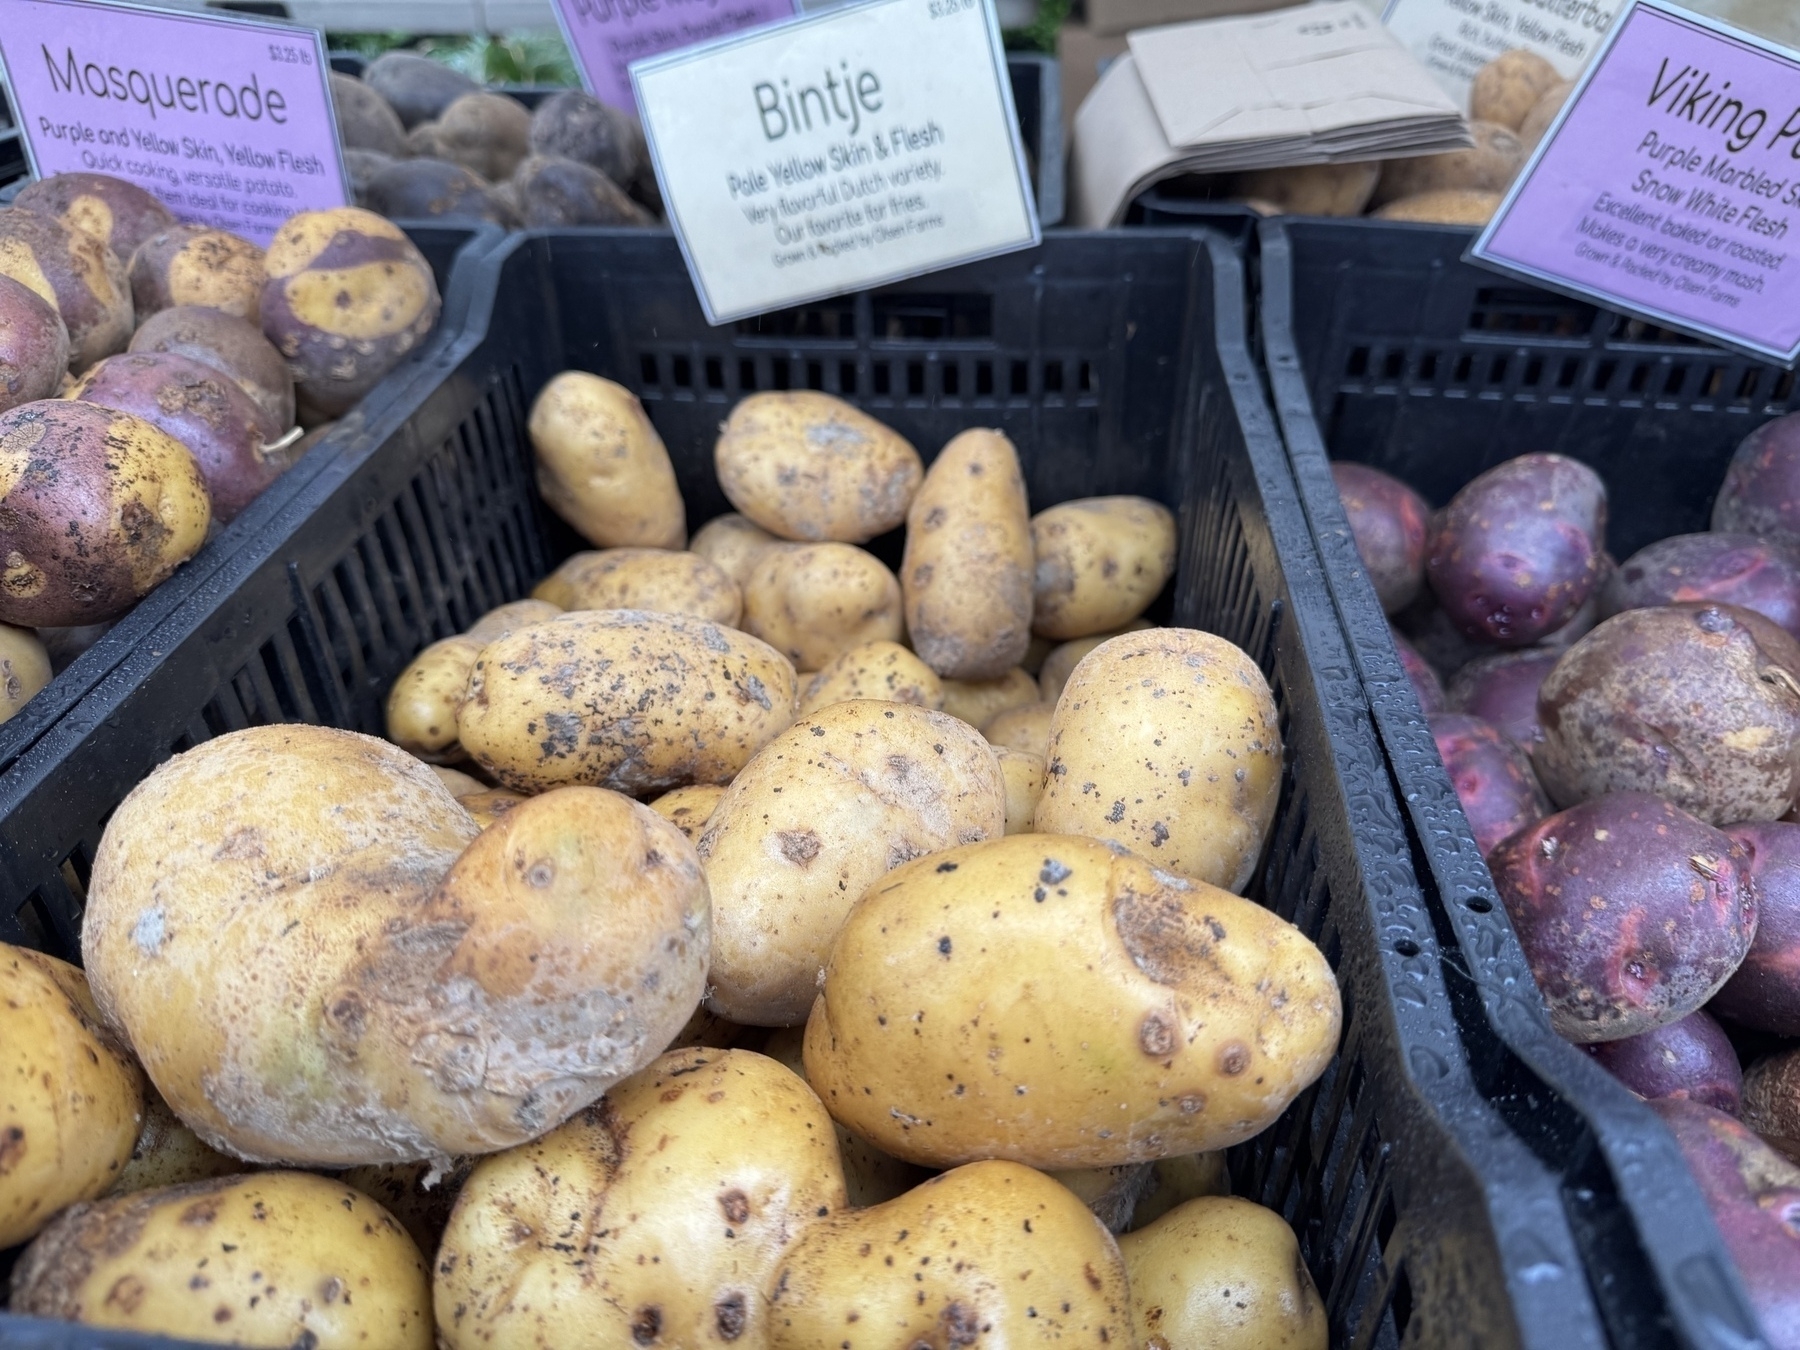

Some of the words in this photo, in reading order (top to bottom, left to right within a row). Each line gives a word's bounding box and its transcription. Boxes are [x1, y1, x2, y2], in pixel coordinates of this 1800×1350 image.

[41, 43, 288, 124] Masquerade
[753, 59, 883, 142] Bintje
[1647, 56, 1767, 153] Viking
[39, 115, 96, 146] Purple
[98, 127, 130, 148] and
[130, 127, 179, 156] Yellow
[181, 135, 224, 167] Skin,
[223, 141, 276, 170] Yellow
[277, 147, 326, 177] Flesh
[81, 149, 125, 173] Quick
[183, 167, 243, 193] versatile
[727, 169, 768, 200] Pale
[766, 154, 827, 188] Yellow
[828, 140, 872, 172] Skin
[873, 131, 889, 160] &
[889, 117, 944, 156] Flesh
[1636, 129, 1702, 171] Purple
[1700, 153, 1789, 199] Marbled
[740, 199, 778, 226] Very
[838, 170, 887, 202] Dutch
[774, 218, 805, 246] Our
[805, 203, 865, 238] favorite
[863, 195, 887, 223] for
[1592, 190, 1663, 232] Excellent
[1660, 213, 1711, 246] baked
[1706, 232, 1727, 251] or
[1723, 239, 1787, 272] roasted.
[1631, 168, 1686, 205] Snow
[1684, 186, 1740, 224] White
[1735, 204, 1789, 240] Flesh
[1574, 239, 1611, 264] Grown
[1620, 255, 1661, 283] Packed
[1657, 268, 1675, 290] by
[1576, 214, 1626, 248] Makes
[1624, 236, 1639, 252] a
[1638, 239, 1672, 266] very
[1669, 251, 1725, 283] creamy
[1721, 267, 1765, 294] mash.
